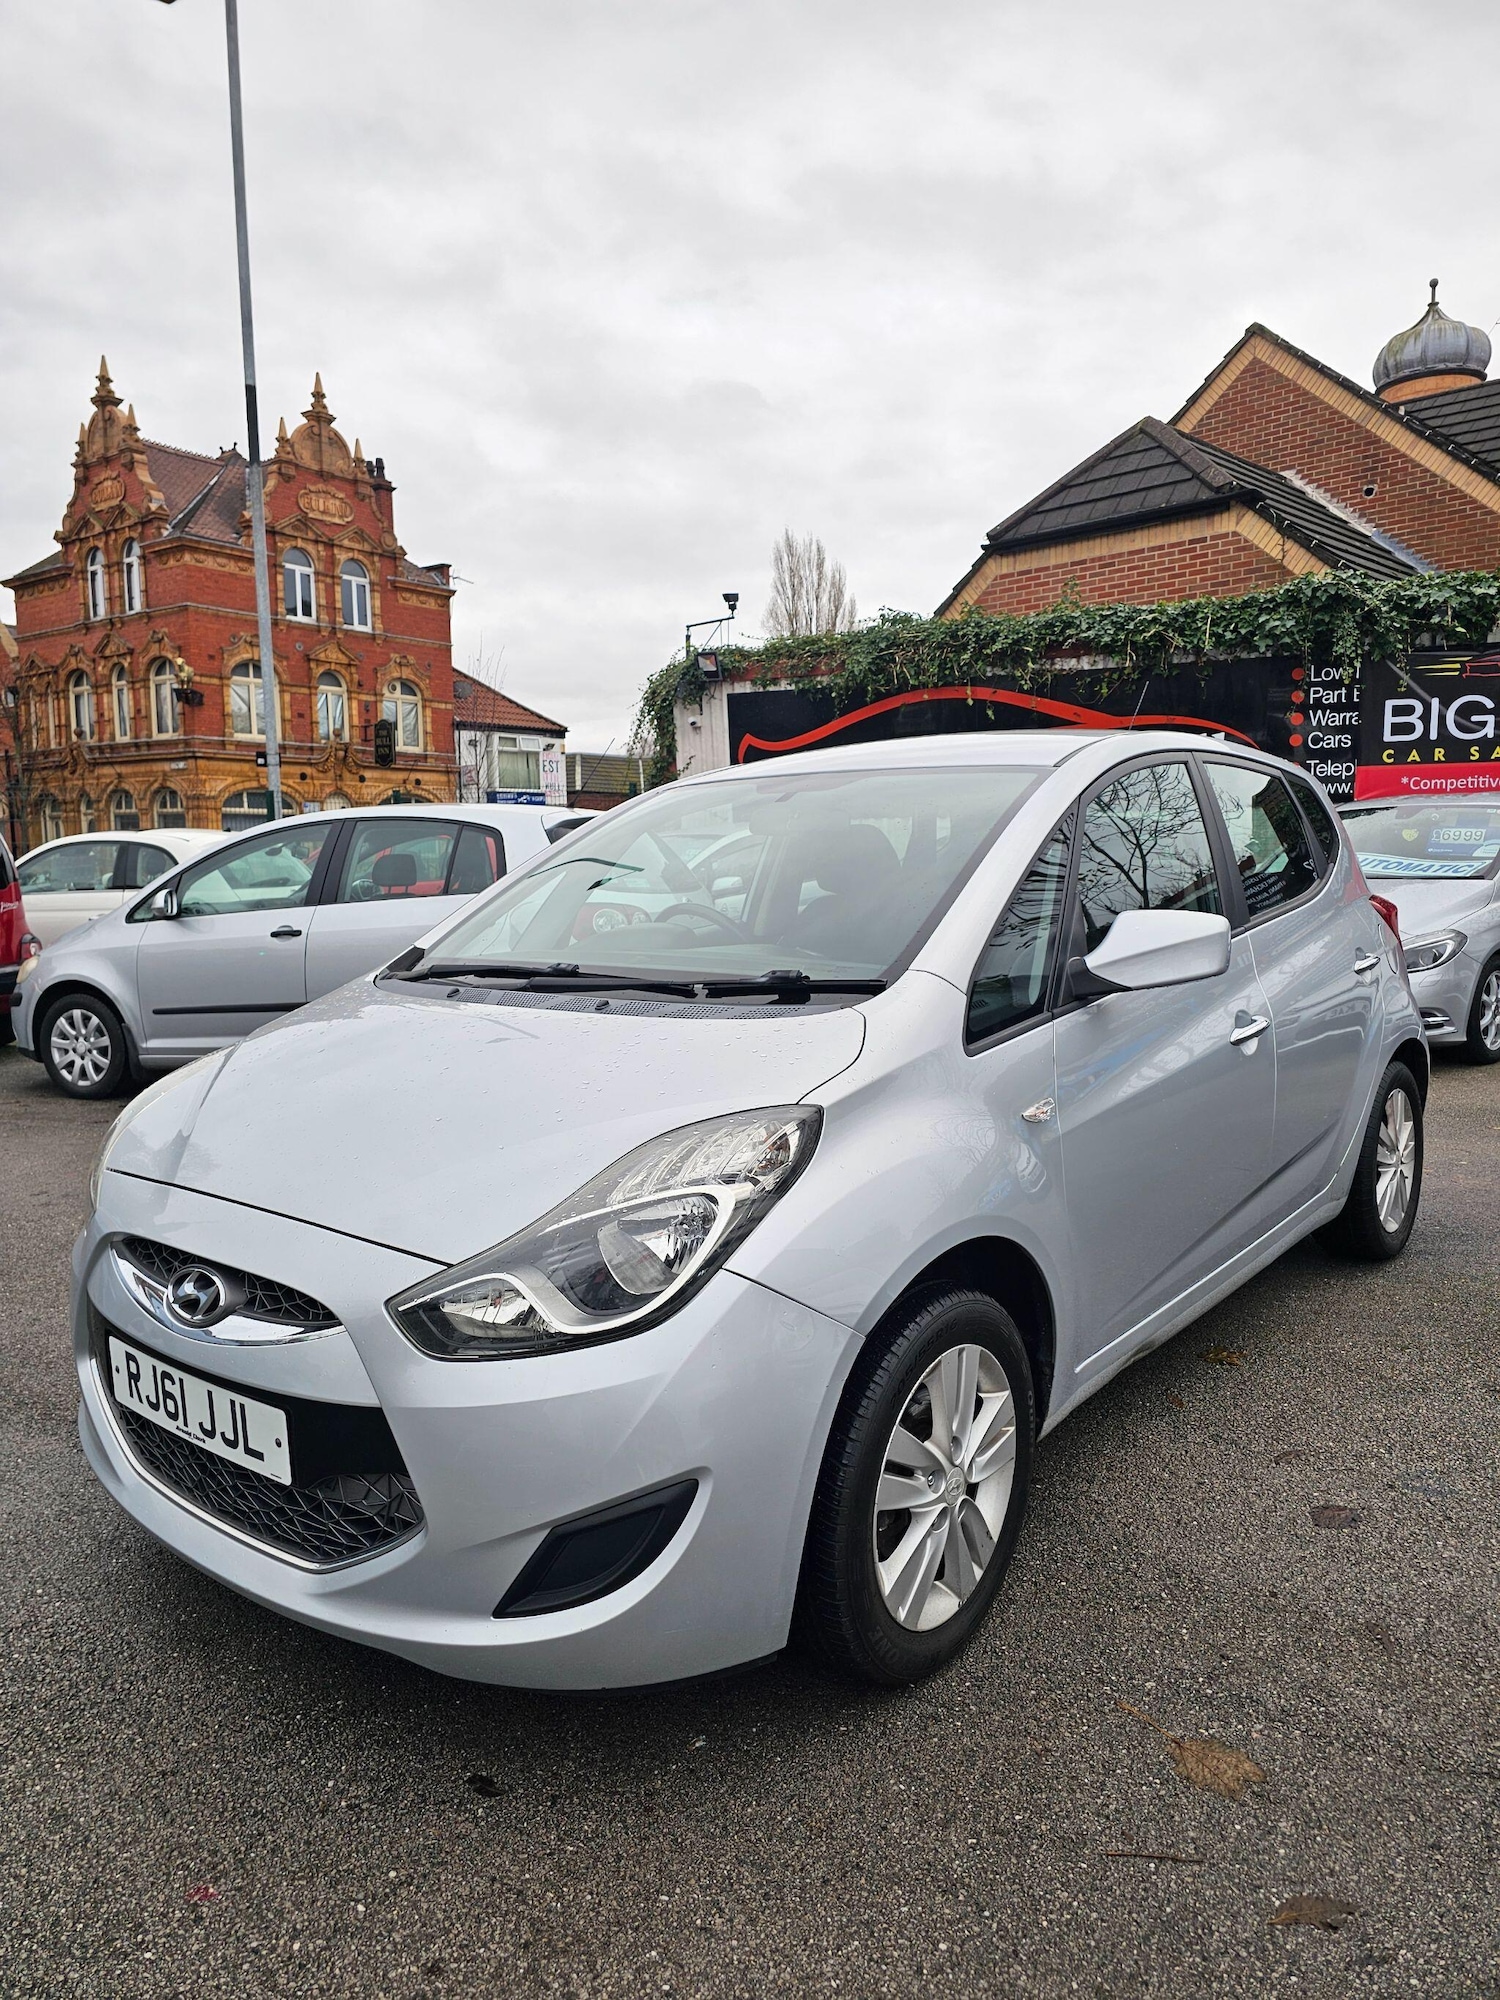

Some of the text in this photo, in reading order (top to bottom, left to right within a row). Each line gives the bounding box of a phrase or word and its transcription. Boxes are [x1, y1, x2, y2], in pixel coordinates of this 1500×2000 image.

[1309, 686, 1347, 705] Part
[1382, 694, 1496, 743] BIG
[1307, 731, 1352, 749] Cars
[1381, 747, 1446, 764] CAR
[542, 759, 560, 773] EST
[1306, 759, 1357, 780] Telep
[1431, 828, 1484, 842] £6999
[124, 1350, 265, 1462] RJ61 JJL
